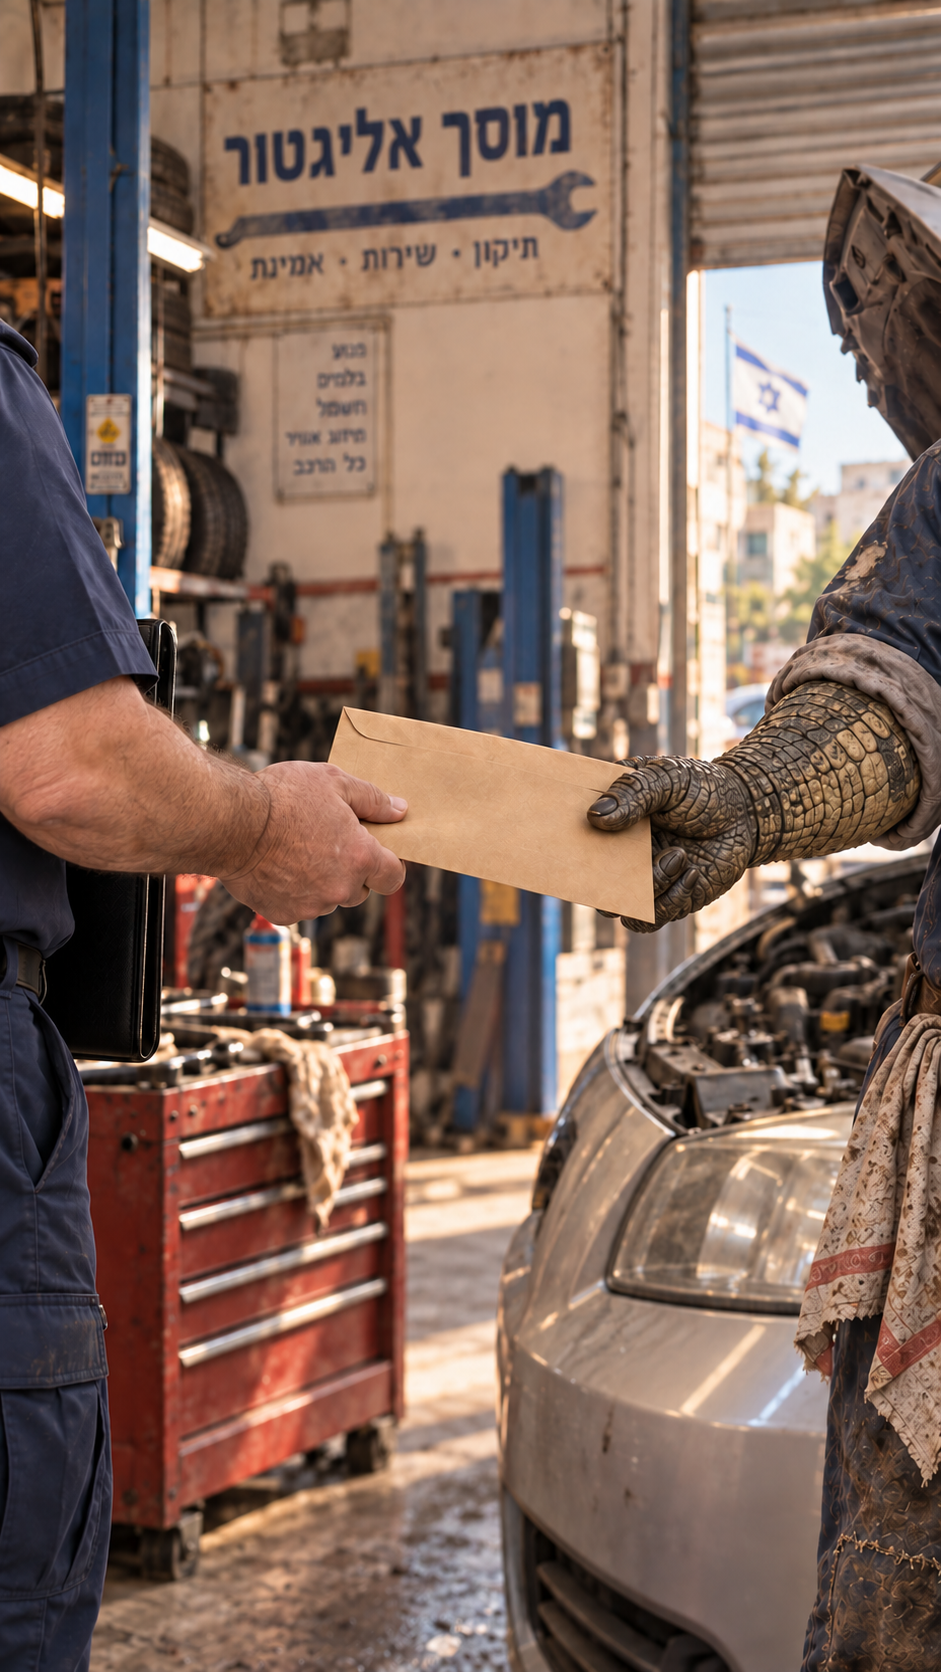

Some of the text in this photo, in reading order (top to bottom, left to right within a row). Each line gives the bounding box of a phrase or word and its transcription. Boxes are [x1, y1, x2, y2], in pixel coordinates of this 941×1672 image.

[224, 98, 571, 185] מוסך אליגטור
[251, 237, 538, 281] תיקון שירות אמינת
[316, 398, 367, 418] חשמל
[343, 453, 367, 472] כל
